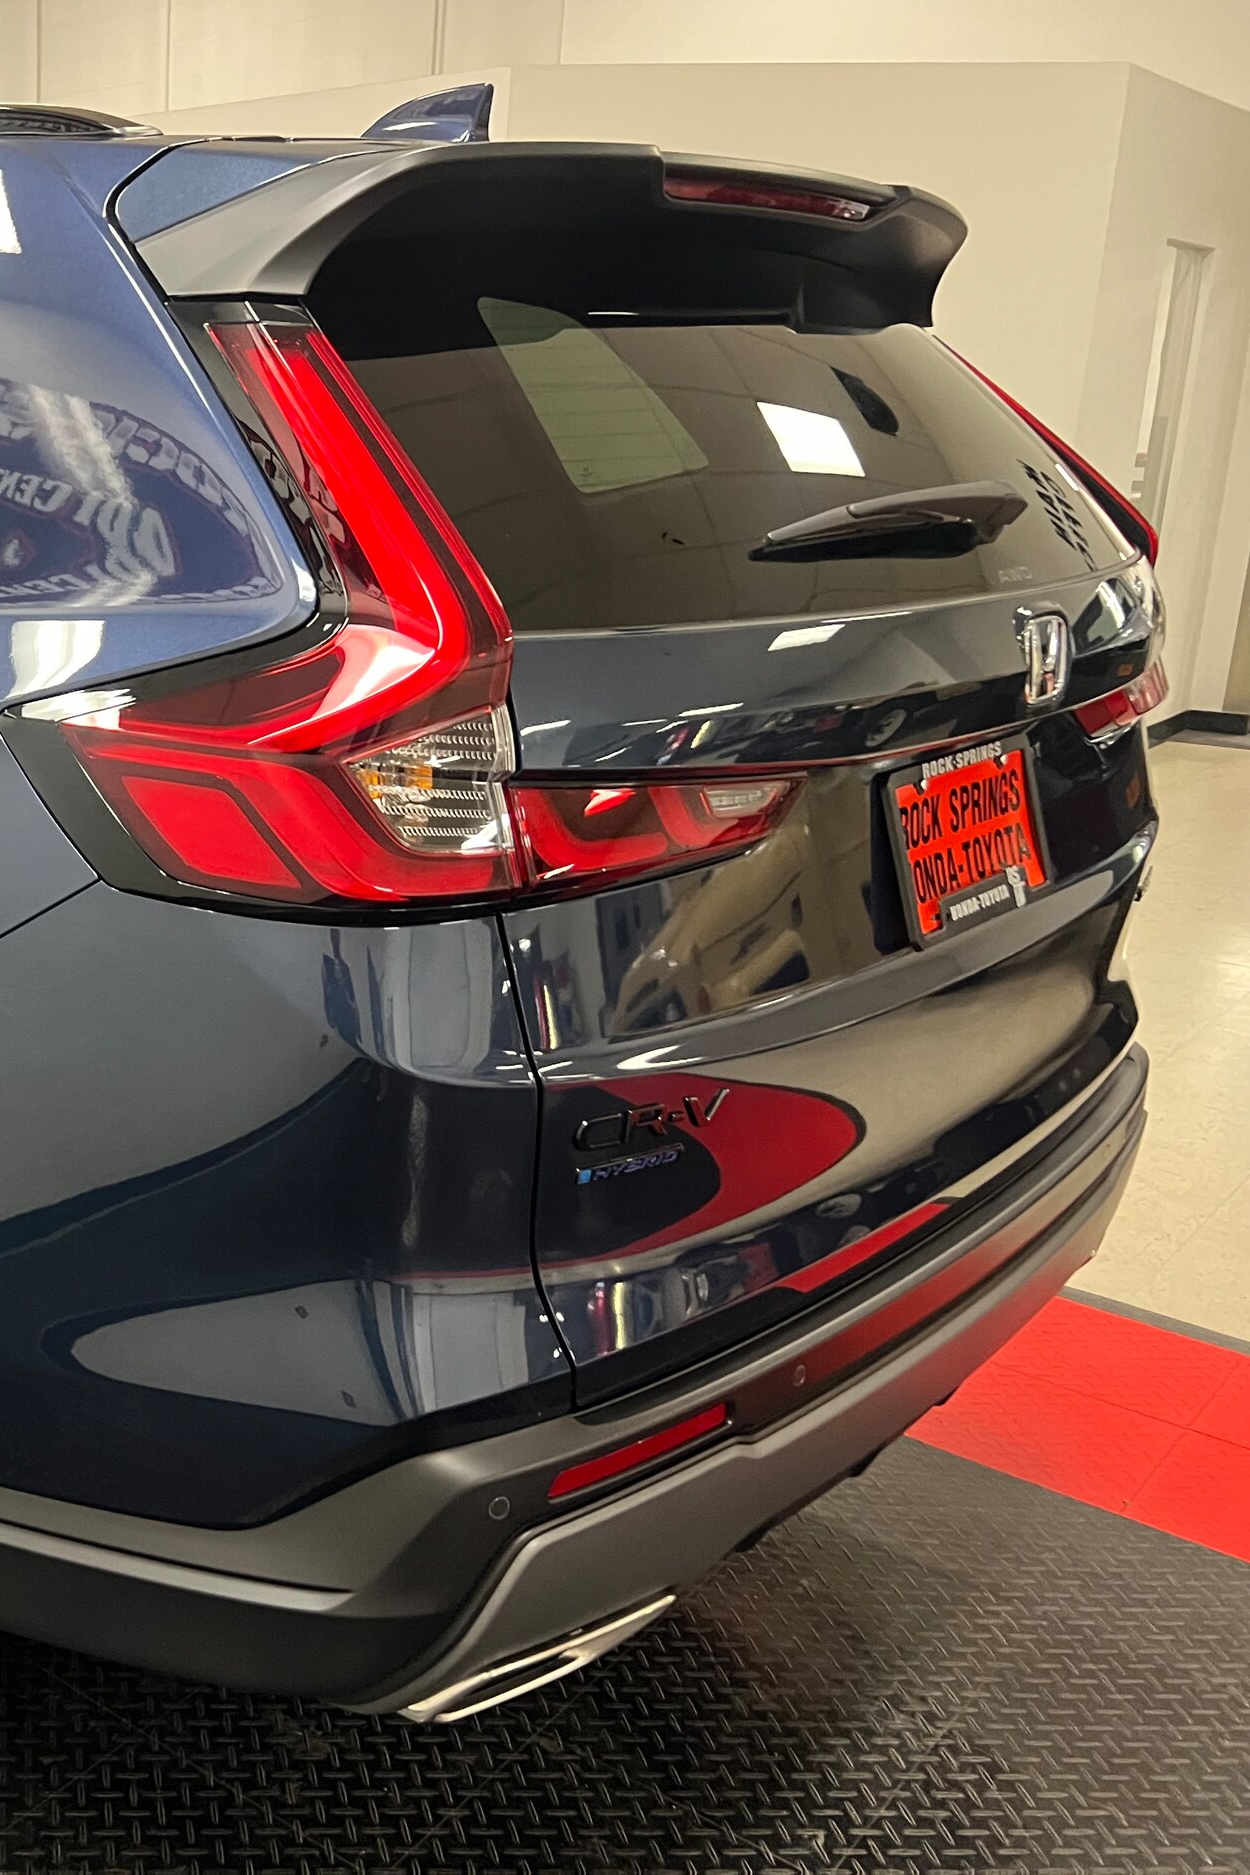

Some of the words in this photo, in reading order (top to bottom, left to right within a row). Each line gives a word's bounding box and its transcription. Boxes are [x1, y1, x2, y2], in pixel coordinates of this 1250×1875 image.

[900, 793, 943, 850] ROCK
[949, 768, 1021, 833] SPRINGS
[913, 823, 1031, 904] ONDA-TOYOTA
[573, 1088, 730, 1152] CR-V
